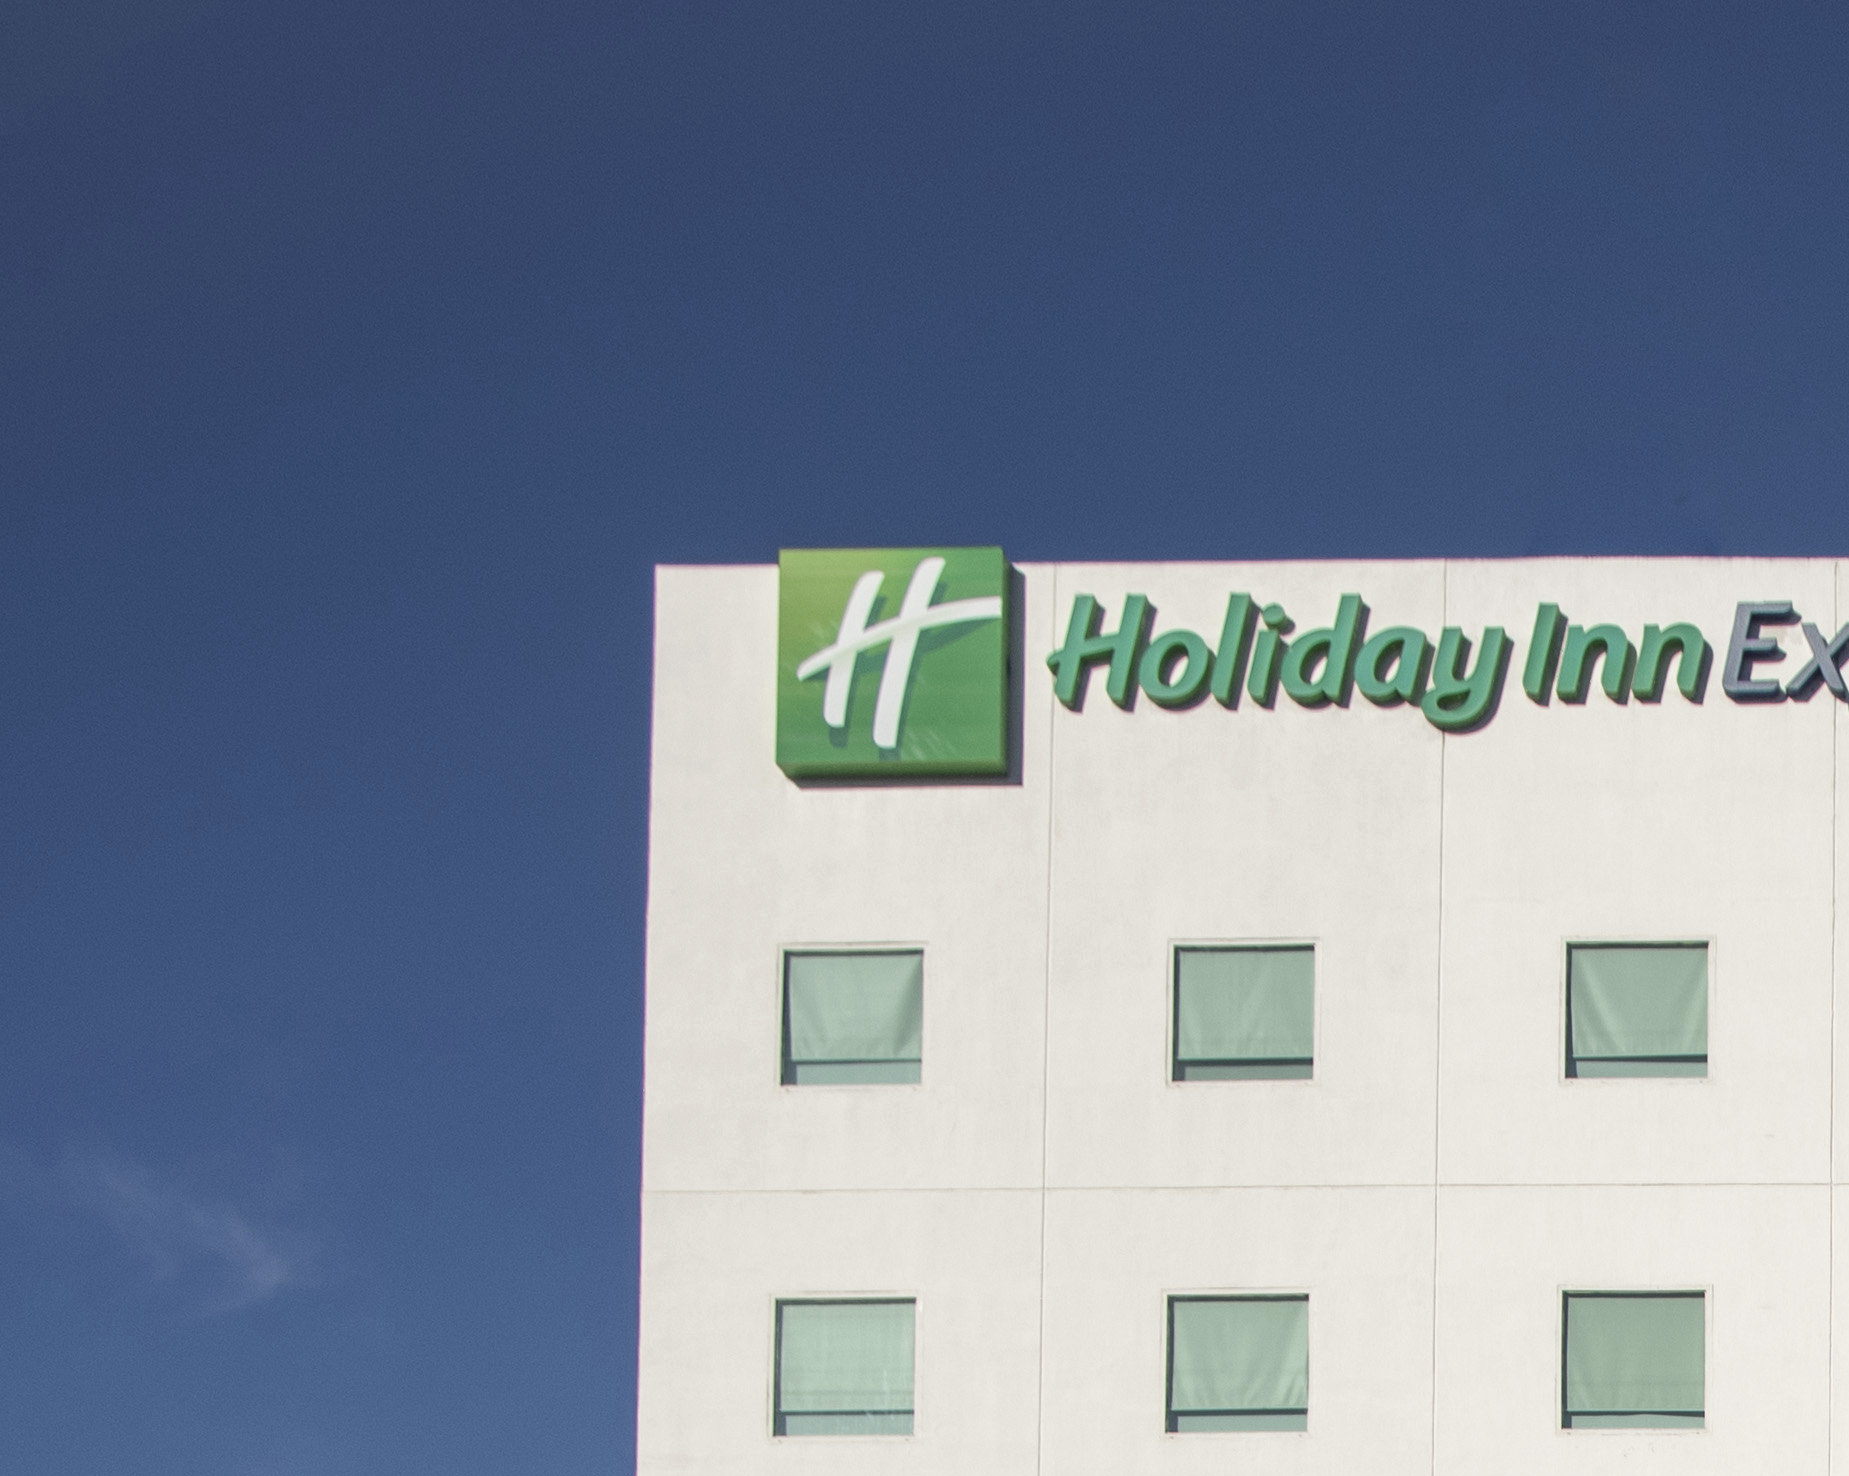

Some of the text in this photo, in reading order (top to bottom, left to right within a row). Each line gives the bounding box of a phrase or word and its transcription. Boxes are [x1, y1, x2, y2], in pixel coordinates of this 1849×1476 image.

[797, 556, 1002, 749] H
[1047, 592, 1513, 732] Holiday
[1522, 602, 1712, 706] Inn
